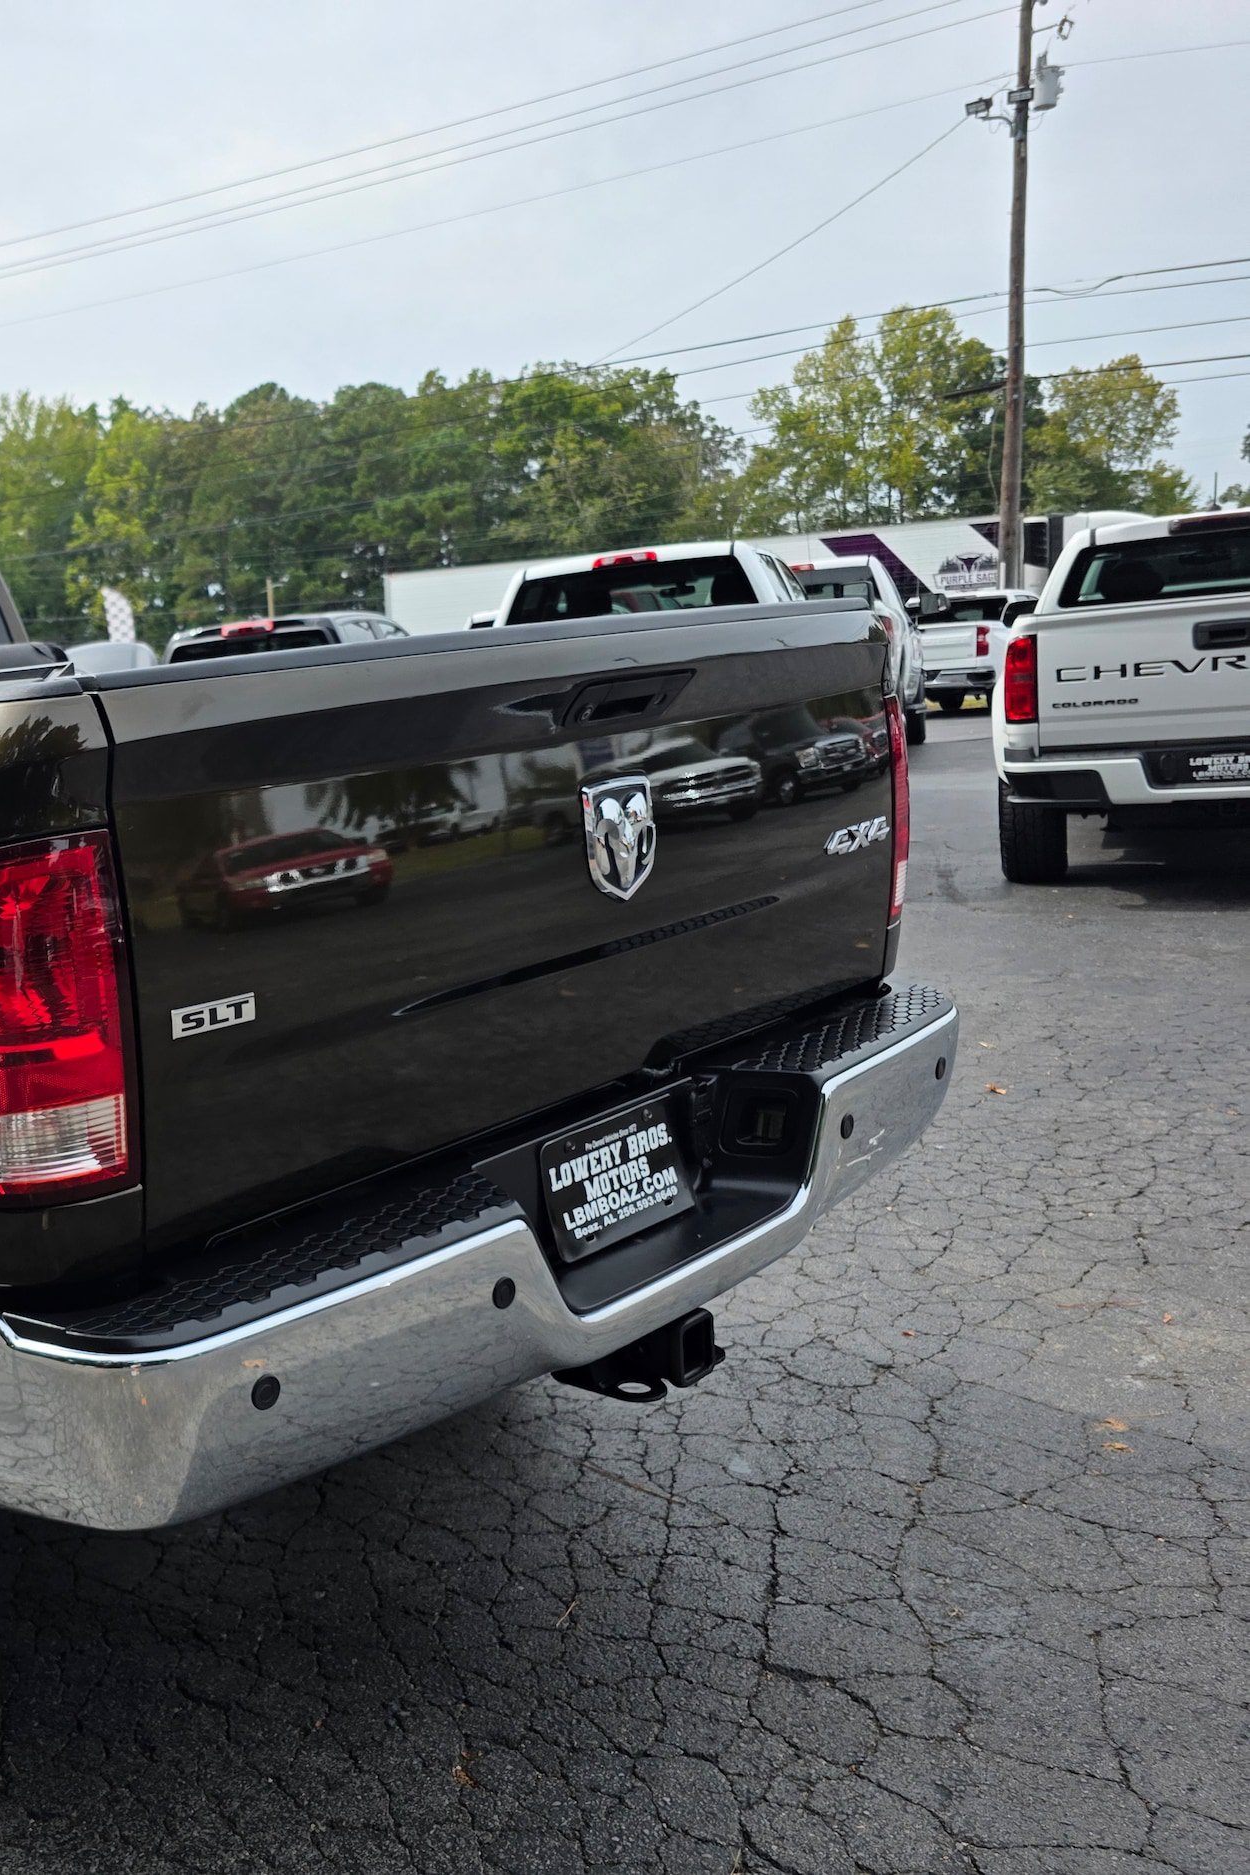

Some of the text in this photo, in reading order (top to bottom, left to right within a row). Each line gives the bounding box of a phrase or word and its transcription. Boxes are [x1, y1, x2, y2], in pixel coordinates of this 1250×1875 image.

[940, 574, 973, 585] PURPLE
[1052, 698, 1139, 709] COLORADO
[181, 999, 250, 1033] SLT
[549, 1140, 623, 1192] LOWERY
[626, 1122, 673, 1160] BROS.
[583, 1156, 650, 1202] MOTORS
[563, 1166, 678, 1231] LBMBOAZ.COM
[573, 1185, 679, 1240] Boaz, AL 256.593.8649
